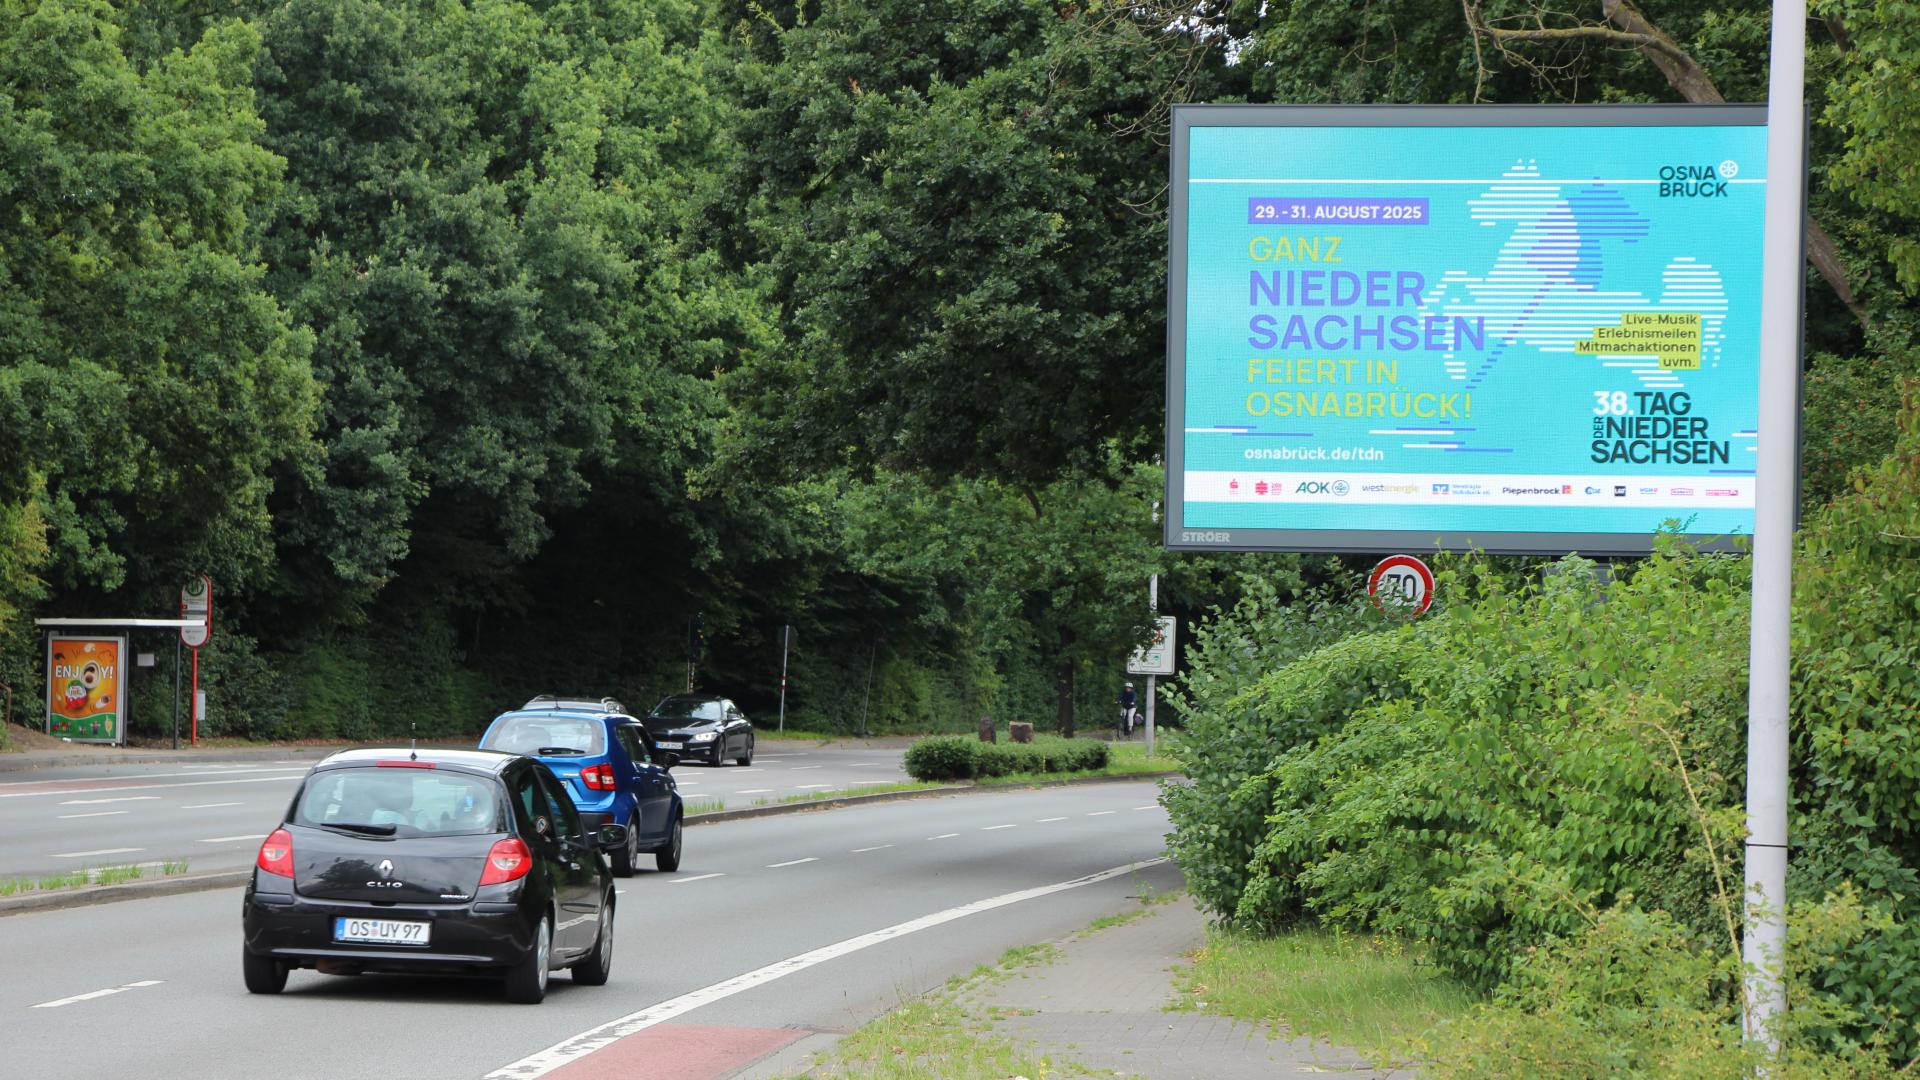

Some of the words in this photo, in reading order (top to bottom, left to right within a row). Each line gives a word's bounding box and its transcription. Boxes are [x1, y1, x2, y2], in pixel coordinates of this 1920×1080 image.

[1659, 165, 1716, 180] OSNA
[1255, 205, 1279, 219] 29.
[1291, 205, 1311, 219] 31.
[1314, 206, 1380, 219] AUGUST
[1383, 206, 1422, 219] 2025
[1249, 236, 1342, 262] GANZ
[1250, 270, 1426, 307] NIEDER
[1625, 314, 1697, 325] Live-Musik
[1248, 314, 1485, 351] SACHSEN
[1598, 328, 1697, 339] Erlebnismeilen
[1579, 341, 1696, 353] Mitmachaktionen
[1247, 359, 1359, 384] FEIERT
[1366, 360, 1398, 384] IN
[1663, 357, 1696, 367] uvm.
[1246, 386, 1472, 418] OSNABRÜCK!
[1592, 390, 1634, 416] 38.
[1634, 391, 1692, 416] TAG
[1593, 416, 1604, 438] DER
[1606, 416, 1709, 439] NIEDER
[1244, 446, 1384, 461] osnabrück.de/tdn
[1590, 439, 1730, 464] SACHSEN
[1295, 481, 1330, 494] AOK
[1502, 487, 1560, 495] Piepenbrock
[1181, 531, 1230, 543] STRÖER
[1387, 573, 1417, 602] 70
[350, 920, 370, 936] OS
[379, 923, 401, 938] UY
[403, 924, 422, 939] 97
